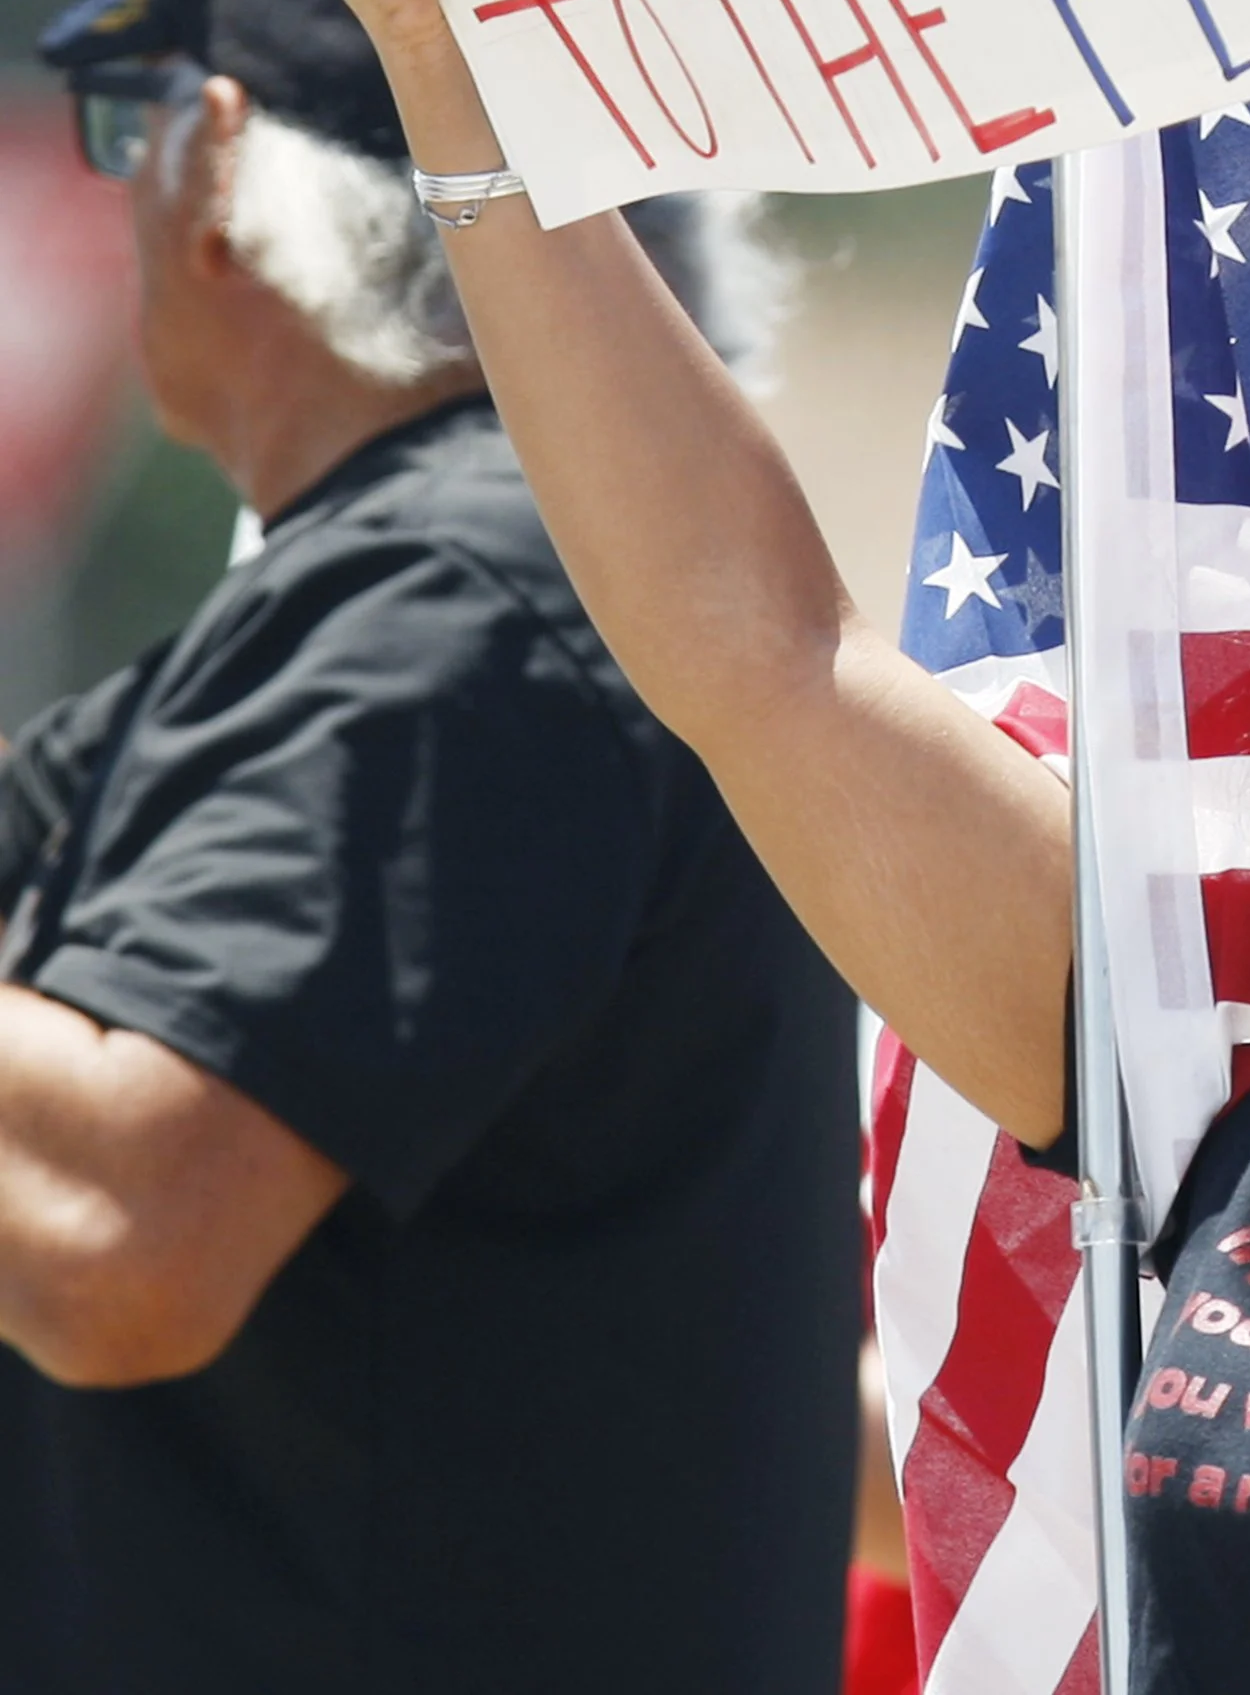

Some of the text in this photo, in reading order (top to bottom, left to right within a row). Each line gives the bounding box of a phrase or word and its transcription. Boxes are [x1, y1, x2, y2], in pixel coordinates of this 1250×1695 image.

[1132, 1366, 1233, 1420] ou
[1123, 1440, 1179, 1497] or
[1187, 1463, 1227, 1510] a
